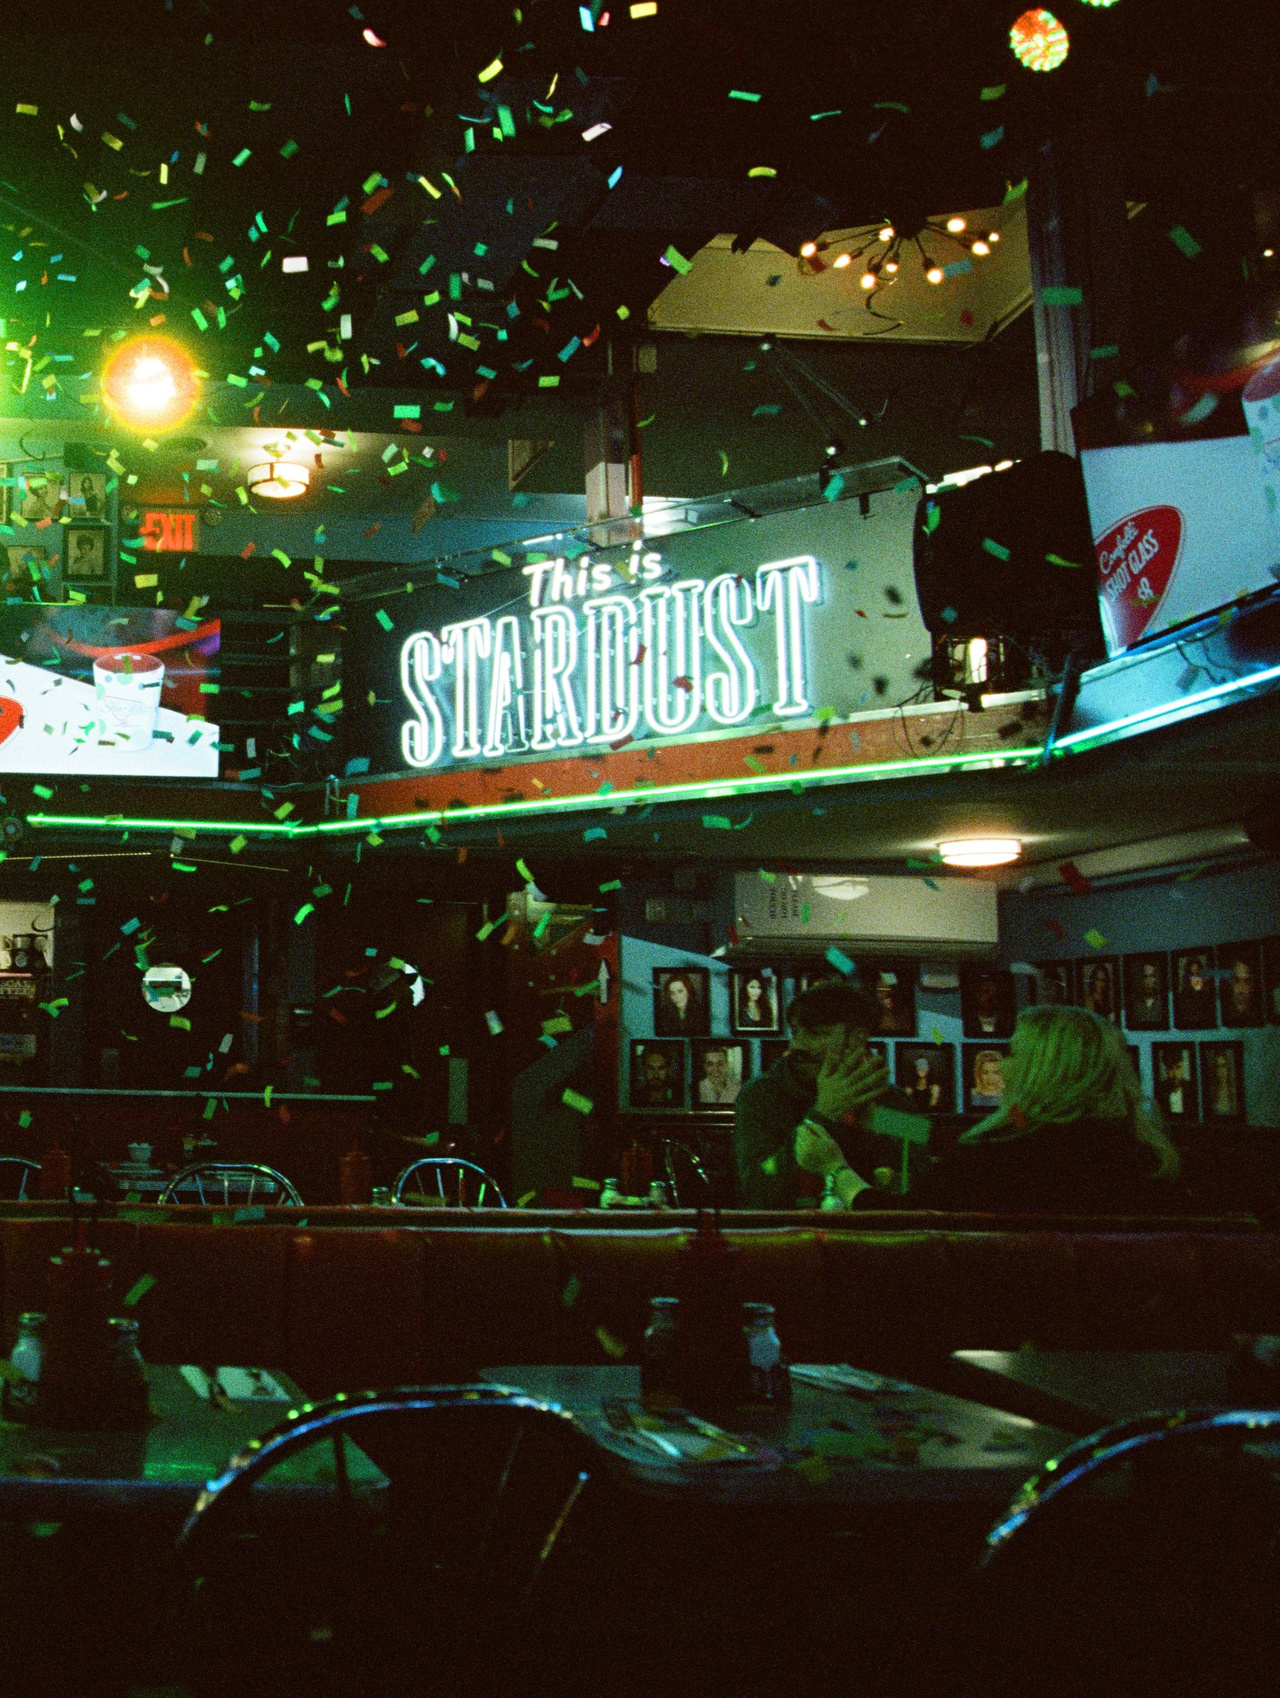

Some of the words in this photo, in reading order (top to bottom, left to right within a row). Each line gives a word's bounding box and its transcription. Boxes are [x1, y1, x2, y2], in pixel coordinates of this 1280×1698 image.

[144, 511, 196, 551] EXIT
[1105, 562, 1133, 603] SHOT
[1128, 528, 1160, 576] GLASS
[520, 555, 613, 608] This
[626, 538, 664, 582] is
[399, 555, 821, 768] STARDUST
